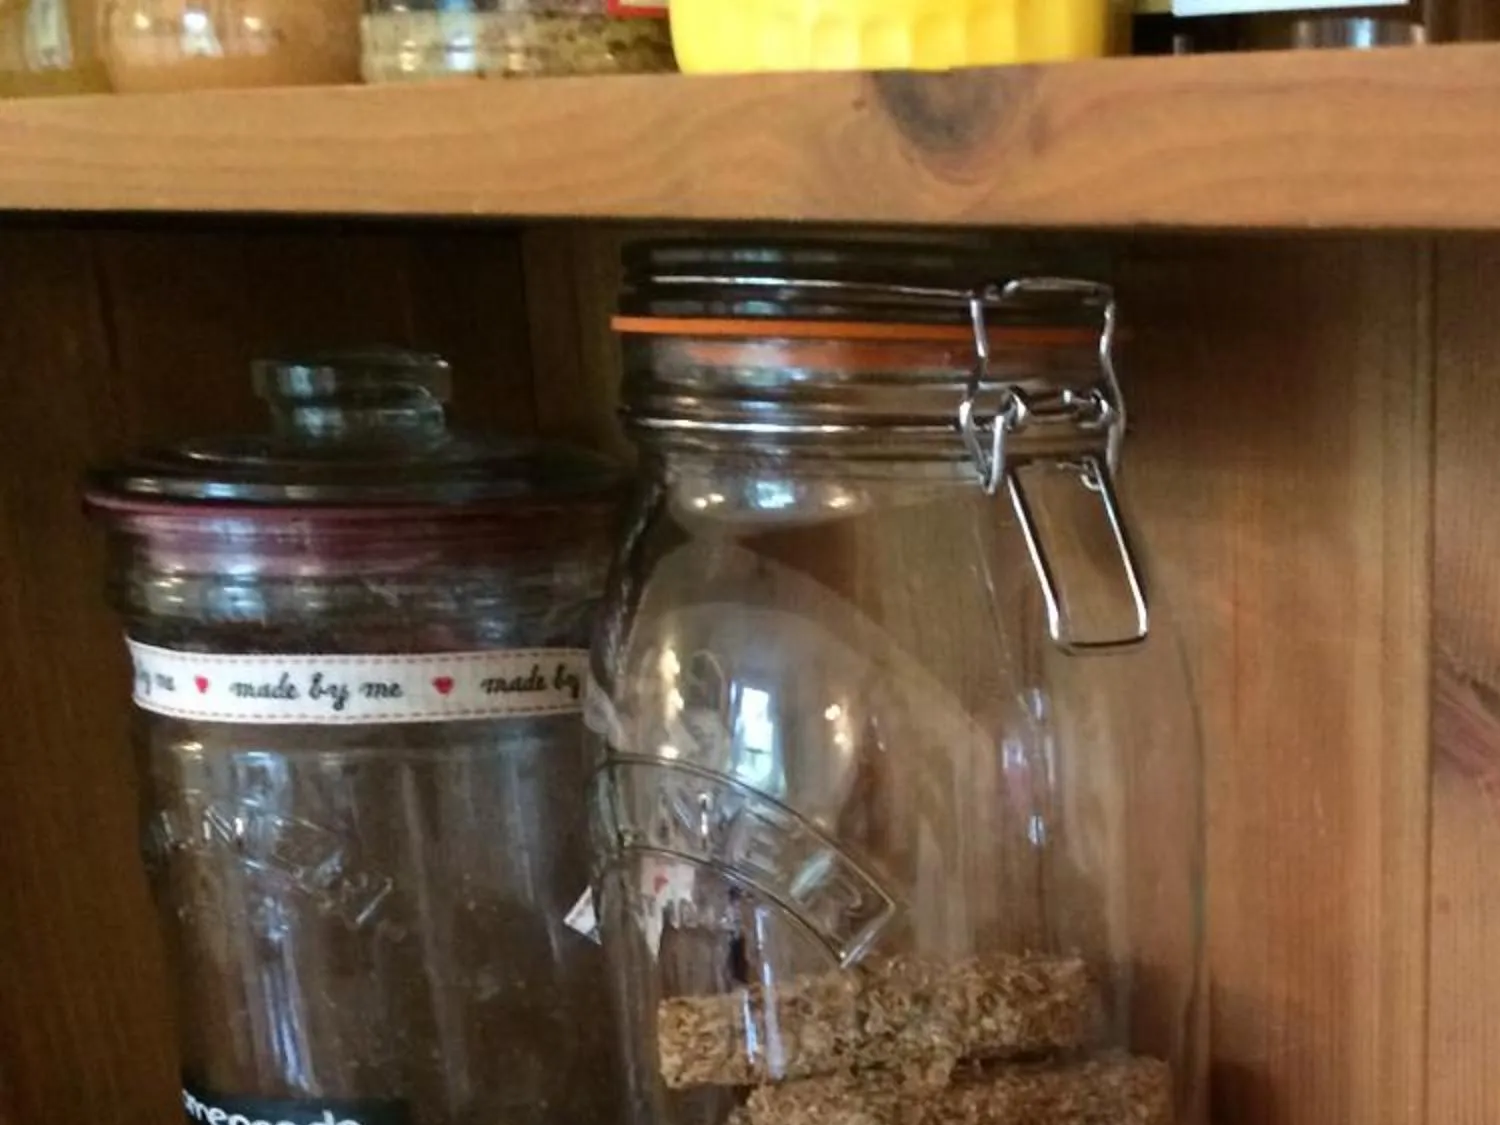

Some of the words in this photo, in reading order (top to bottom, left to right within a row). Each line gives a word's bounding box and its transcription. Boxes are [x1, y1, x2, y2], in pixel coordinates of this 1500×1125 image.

[229, 672, 299, 700] made
[308, 672, 349, 711] by
[359, 680, 404, 699] me
[479, 663, 548, 695] made
[553, 662, 581, 700] by
